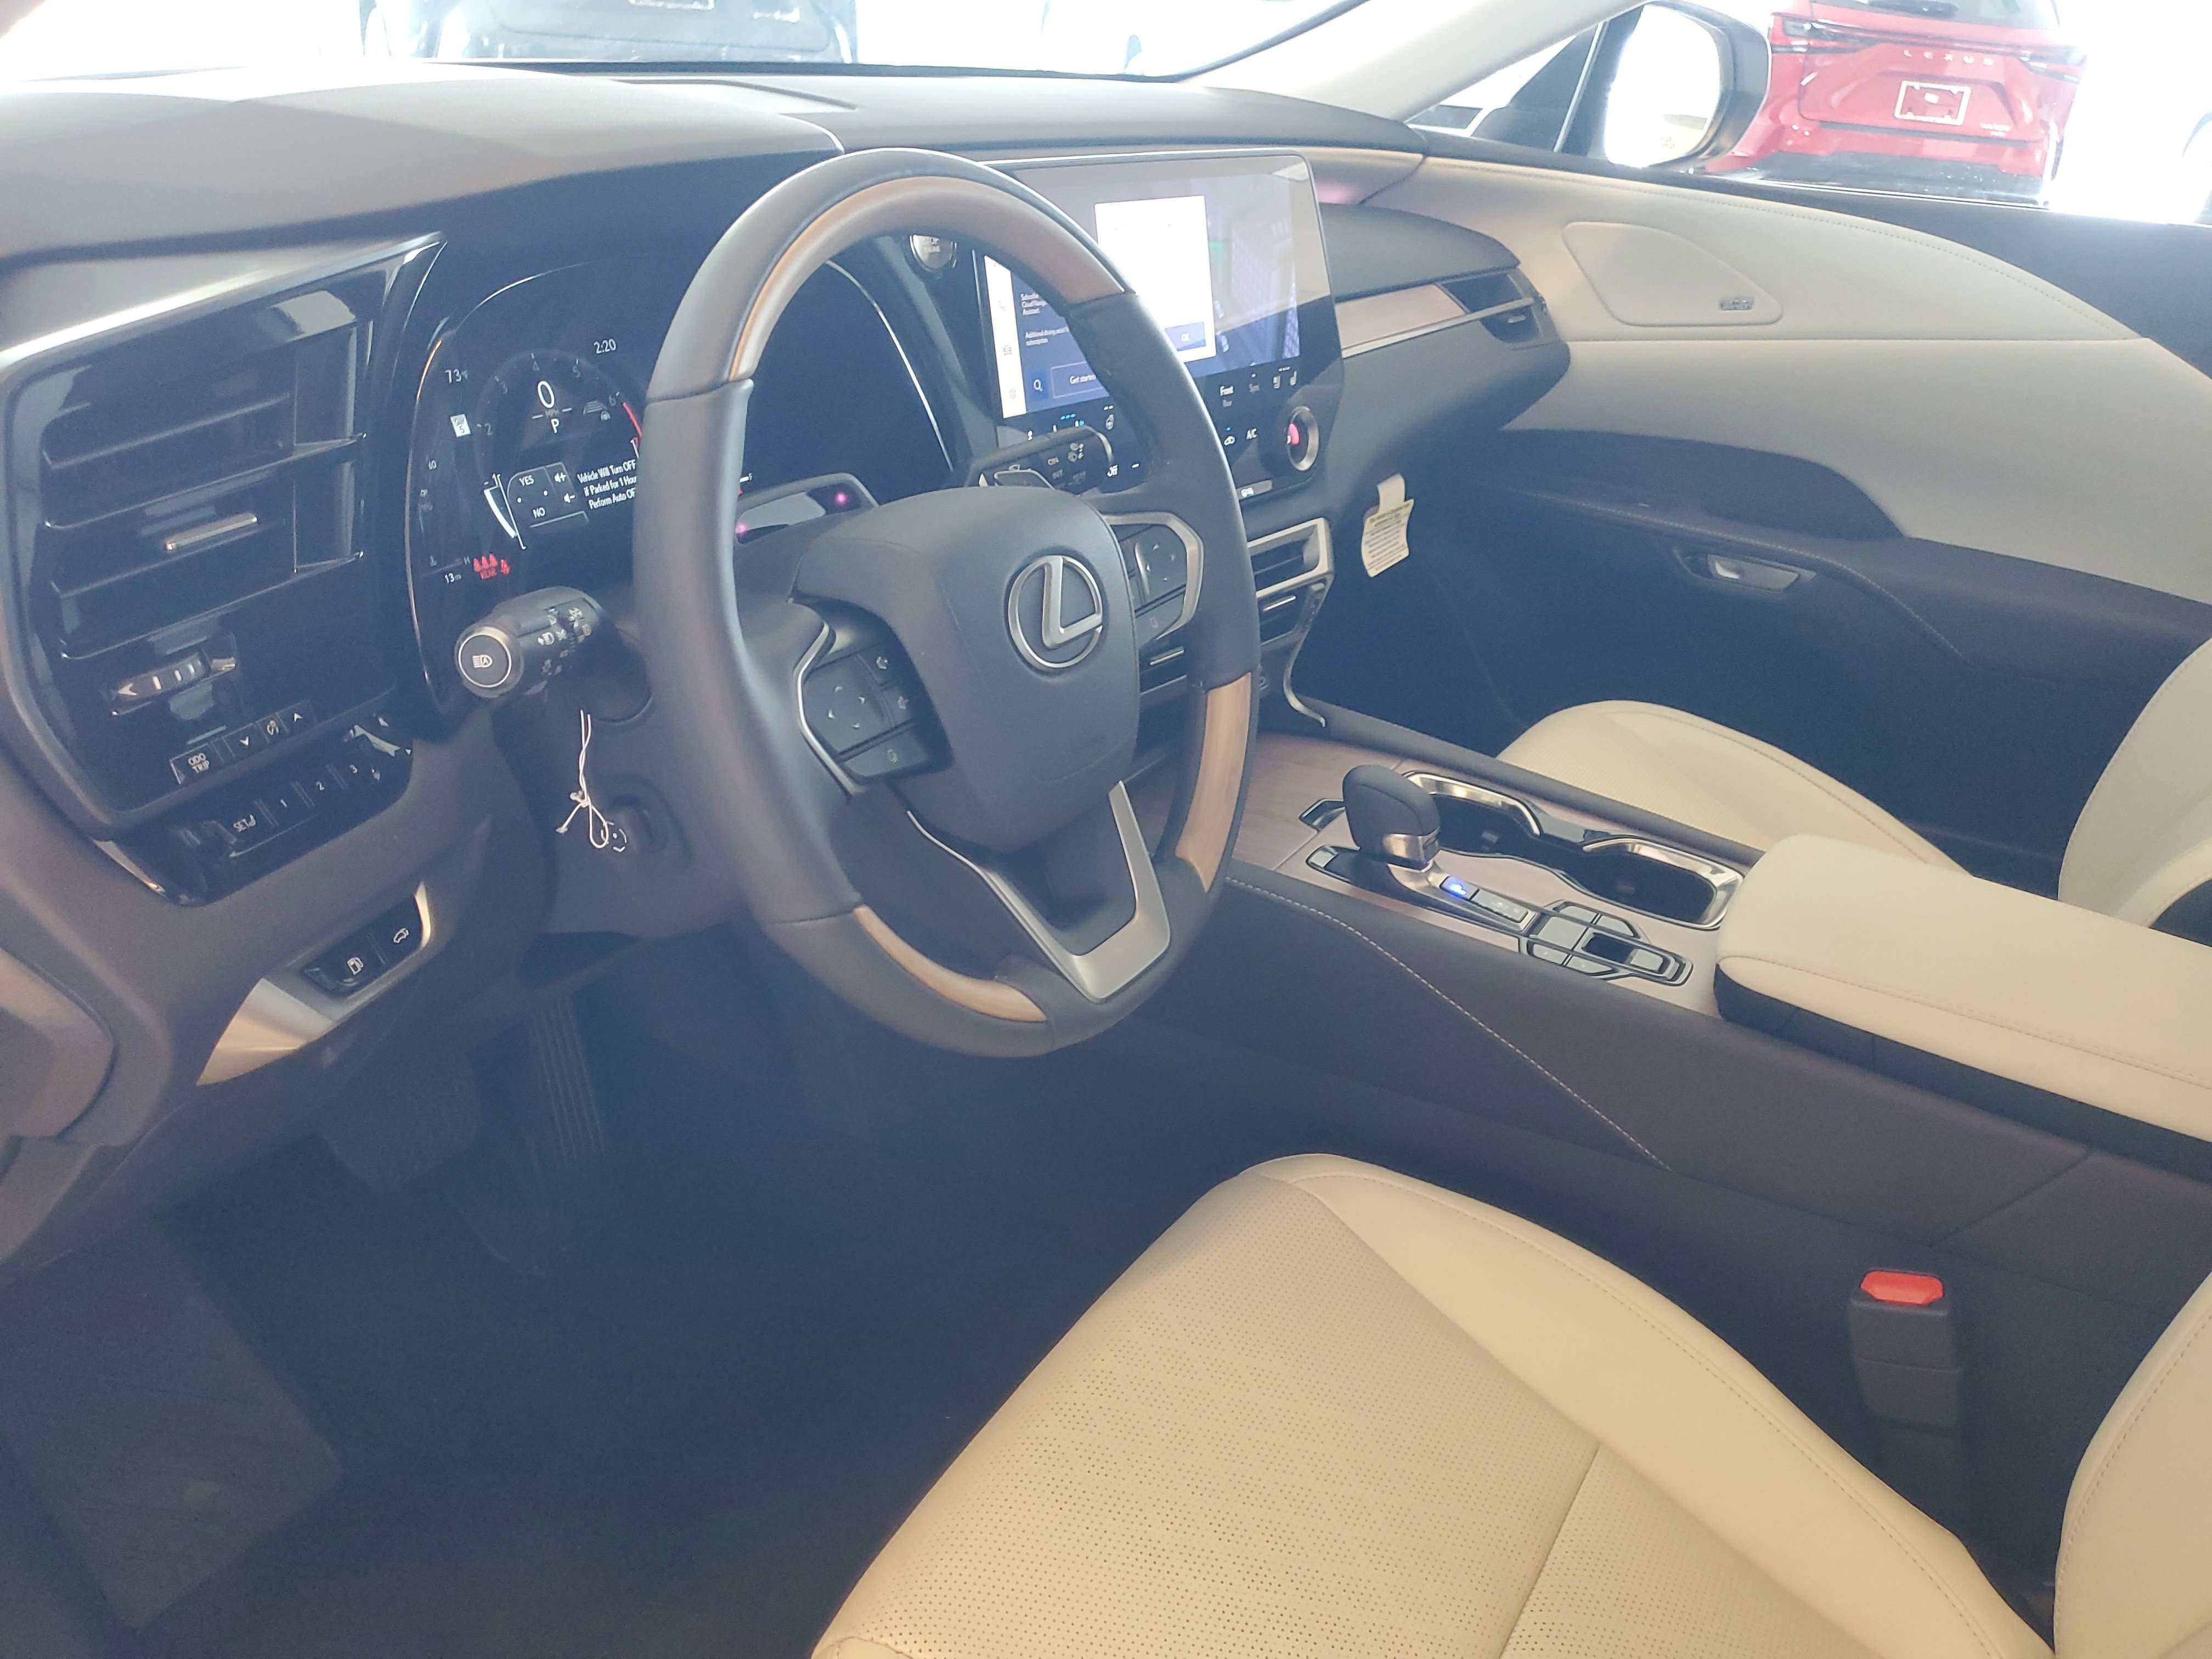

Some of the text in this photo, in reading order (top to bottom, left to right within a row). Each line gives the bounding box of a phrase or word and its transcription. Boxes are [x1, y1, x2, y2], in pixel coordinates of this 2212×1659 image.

[1903, 49, 1994, 66] LEXUS
[594, 338, 617, 354] 2:20
[537, 380, 555, 409] 0
[551, 417, 560, 434] P
[577, 459, 636, 484] Vehicle Will Turn OFF
[518, 475, 534, 487] YES
[589, 482, 610, 495] Parked
[610, 479, 619, 490] for
[618, 477, 624, 487] 1
[588, 497, 612, 510] Perform
[612, 493, 627, 504] Auto
[532, 507, 546, 519] NO
[188, 753, 206, 766] ODO
[192, 760, 210, 774] TRIP
[349, 764, 358, 774] 3
[316, 781, 325, 791] 2
[280, 799, 288, 809] 1
[233, 818, 250, 833] SET
